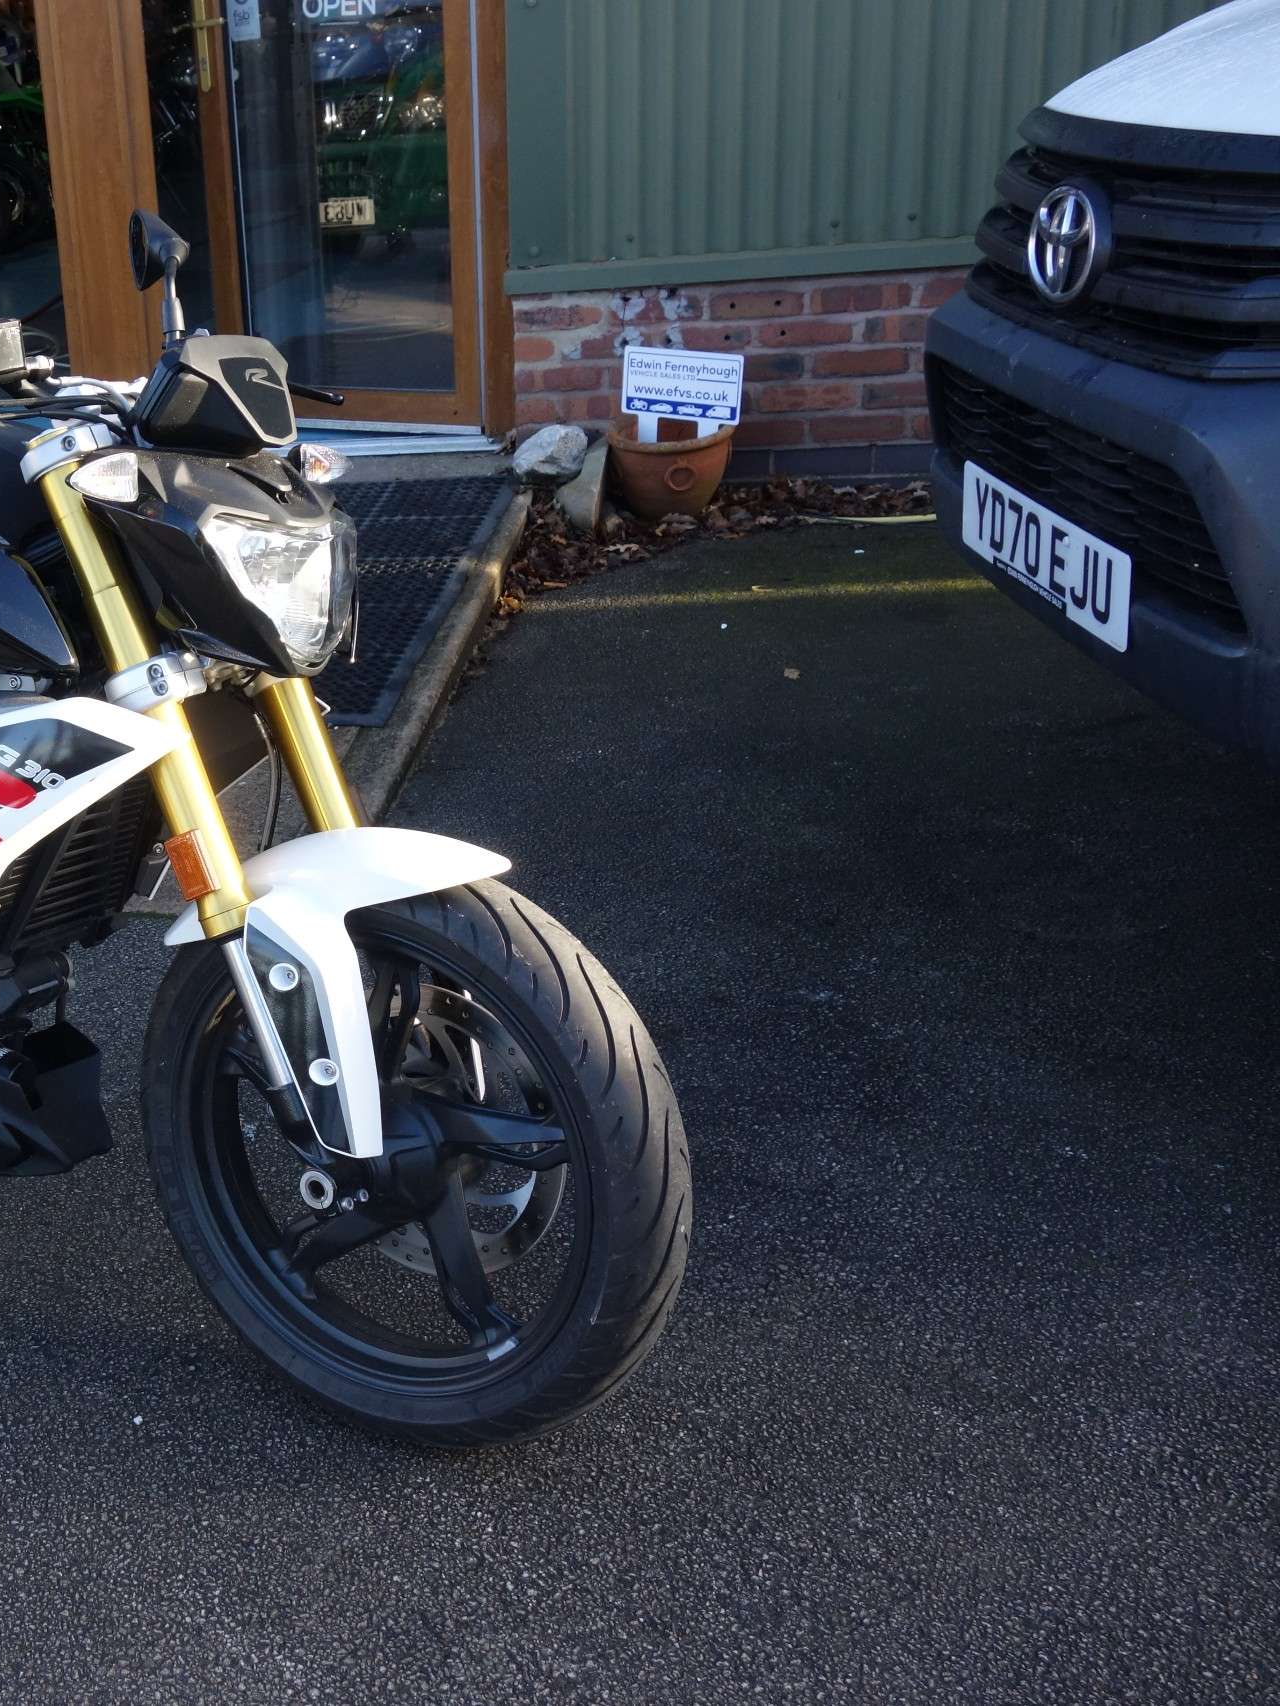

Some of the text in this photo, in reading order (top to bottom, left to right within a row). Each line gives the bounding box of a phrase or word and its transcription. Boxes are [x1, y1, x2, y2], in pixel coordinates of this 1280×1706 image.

[302, 0, 377, 18] OPEN
[630, 359, 738, 378] Edwin Ferneyhough
[630, 370, 658, 378] VEHICLE
[659, 372, 681, 380] SALES
[634, 385, 729, 402] www.efvs.co.uk
[975, 477, 1113, 625] YD70 EJU
[15, 759, 67, 790] 310
